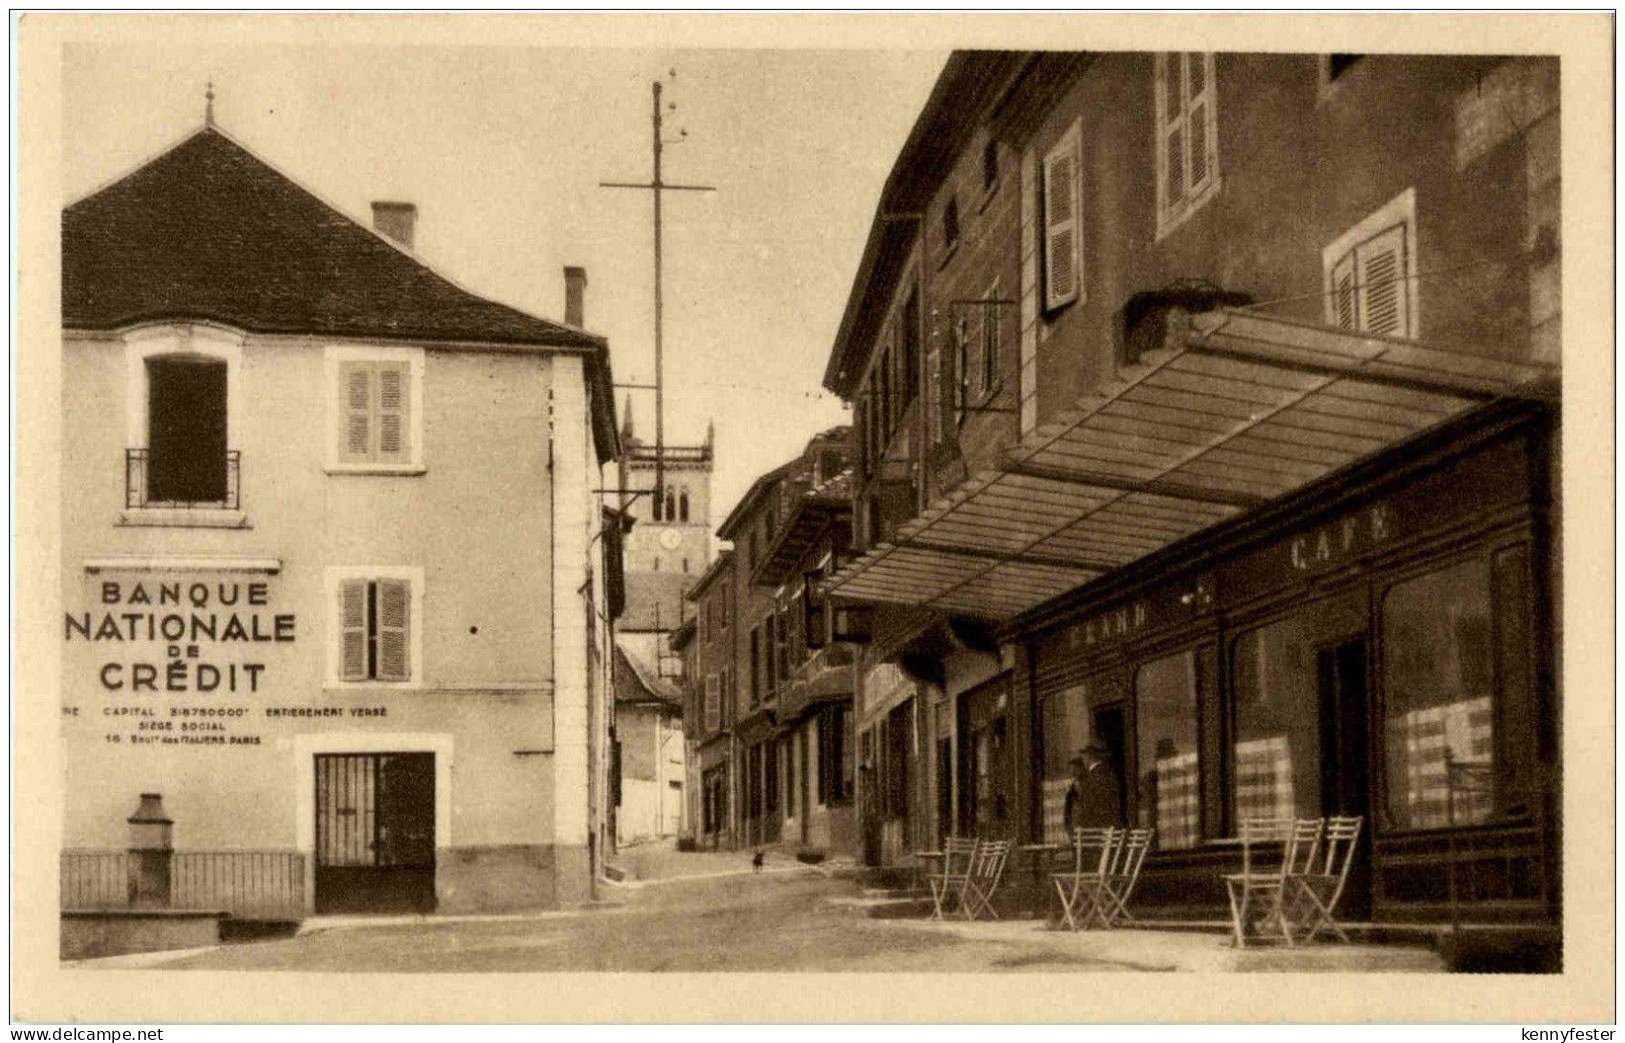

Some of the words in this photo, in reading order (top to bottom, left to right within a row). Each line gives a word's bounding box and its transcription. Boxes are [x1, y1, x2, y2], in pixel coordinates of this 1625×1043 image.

[101, 582, 268, 608] BANQUE
[64, 612, 296, 642] NATIONALE
[167, 645, 200, 658] DE
[100, 660, 266, 692] CRÉDIT
[103, 707, 155, 717] CAPITAL
[181, 722, 226, 732] SOCIAL
[229, 736, 261, 745] PARIS
